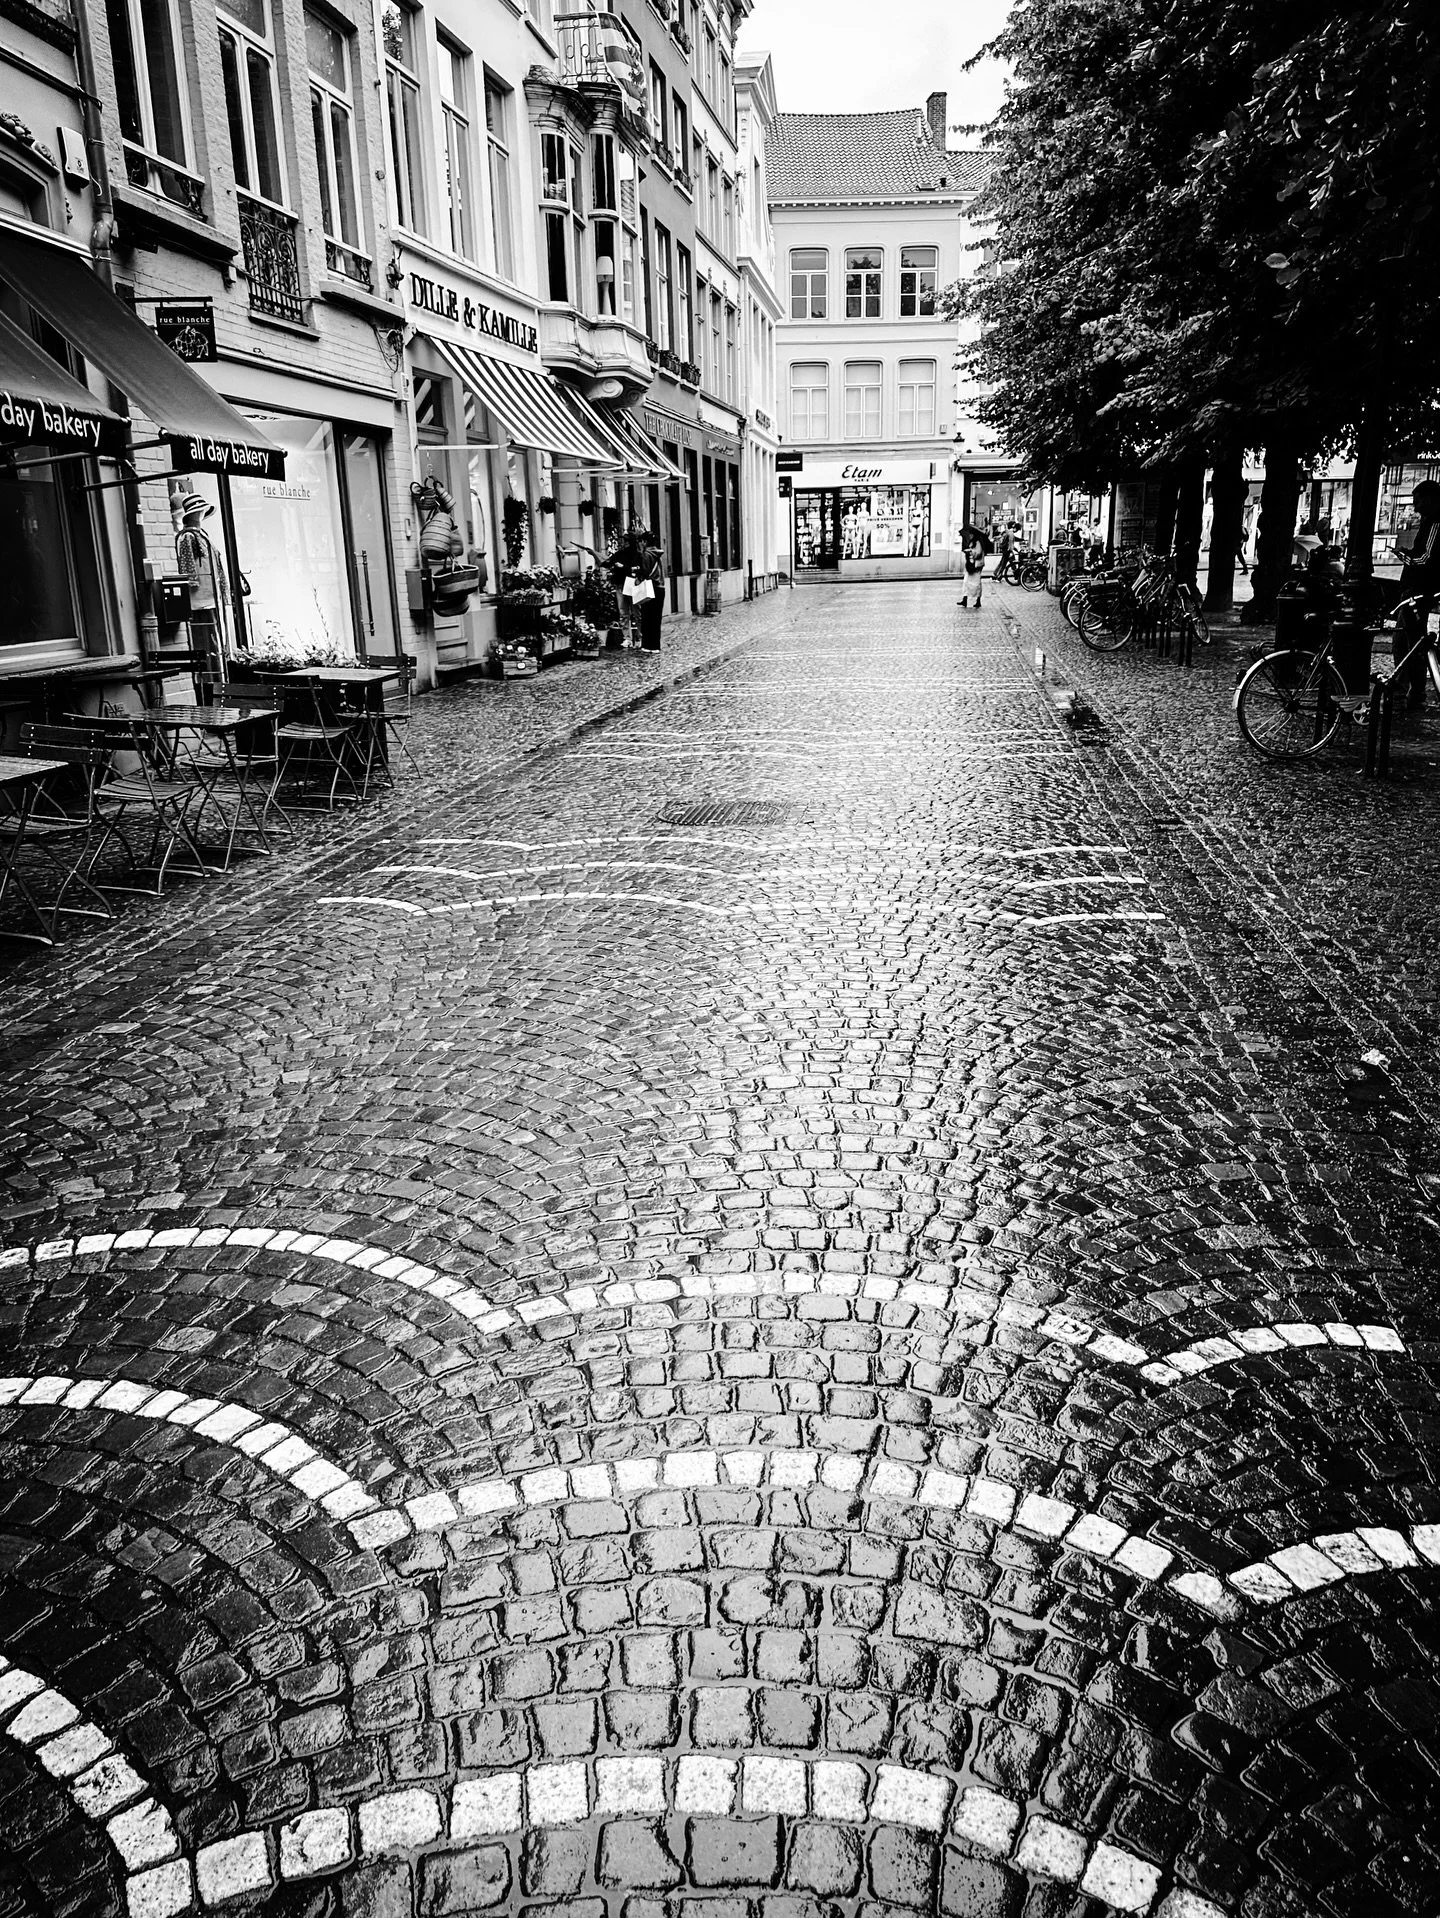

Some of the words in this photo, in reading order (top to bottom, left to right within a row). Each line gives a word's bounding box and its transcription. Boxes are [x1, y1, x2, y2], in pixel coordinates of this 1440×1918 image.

[177, 316, 211, 324] blanche
[410, 272, 459, 322] DILLE
[464, 297, 476, 329] &
[478, 303, 538, 354] KAMILLE
[1, 391, 35, 437] day
[38, 398, 101, 447] bakery
[190, 434, 205, 461] all
[207, 437, 229, 470] day
[229, 439, 269, 474] bakery
[841, 464, 883, 479] Etam
[262, 485, 276, 496] rue
[279, 483, 311, 498] blanche
